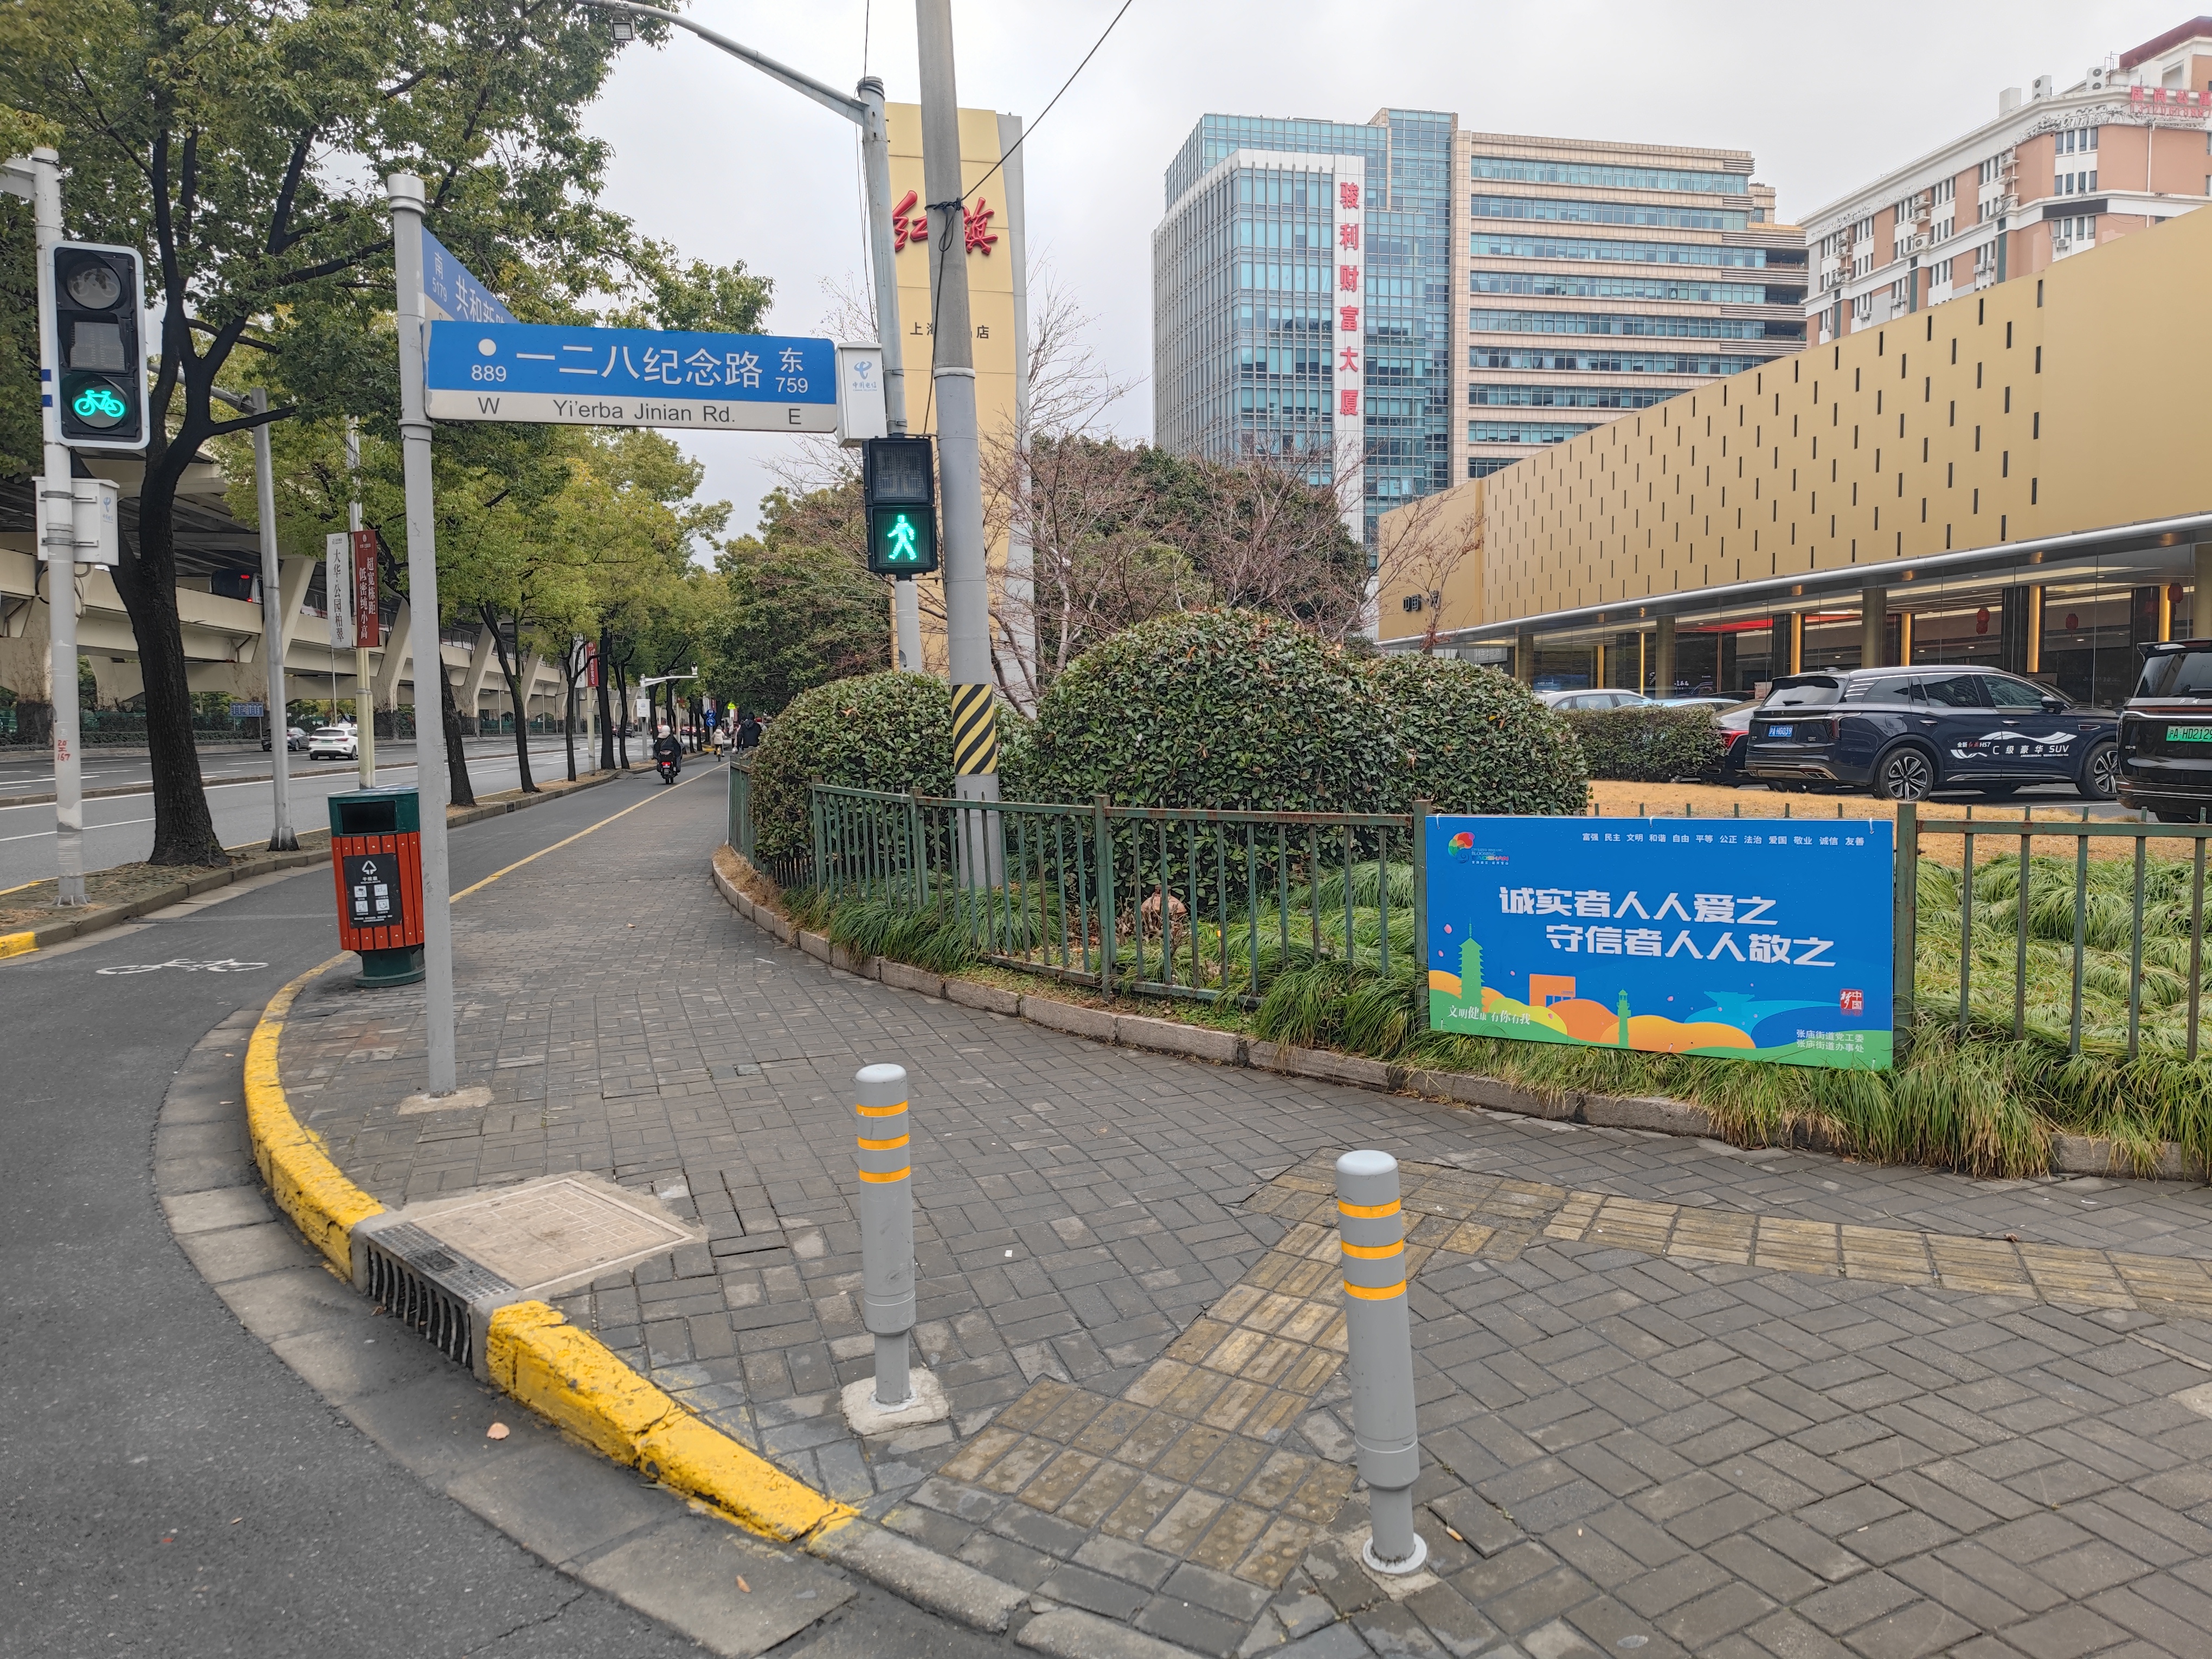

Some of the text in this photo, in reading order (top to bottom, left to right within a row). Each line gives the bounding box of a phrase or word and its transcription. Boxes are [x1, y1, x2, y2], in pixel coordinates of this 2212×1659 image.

[434, 252, 443, 280] 南
[432, 277, 447, 302] 5179
[455, 274, 505, 323] 共和新
[1340, 182, 1359, 416] 骏利财富大厦
[471, 364, 506, 382] 889
[516, 345, 763, 388] 一二八纪念路
[779, 347, 803, 374] 东
[775, 377, 808, 394] 759
[478, 397, 500, 414] W
[553, 400, 735, 422] Yi'erba Jinian Rd.
[789, 408, 801, 425] E
[366, 557, 376, 615] 超宽栋距
[359, 568, 368, 639] 低密纯小高
[1582, 833, 1599, 841] 富强
[1604, 833, 1621, 841] 民主
[1649, 834, 1666, 843] 和谐
[1673, 834, 1689, 843] 自由
[1695, 835, 1713, 843] 平等
[1719, 835, 1737, 844] 公正
[1744, 835, 1762, 844] 法治
[1769, 835, 1787, 845] 爱国
[1793, 836, 1812, 845] 敬业
[1819, 837, 1838, 846] 诚信
[1845, 837, 1864, 846] 友善
[1499, 886, 1778, 925] 诚实者人人爱之
[1546, 924, 1836, 967] 守信者人人敬之
[1796, 1029, 1864, 1043] 张庙街道党工委
[1796, 1039, 1864, 1053] 张庙街道办事处
